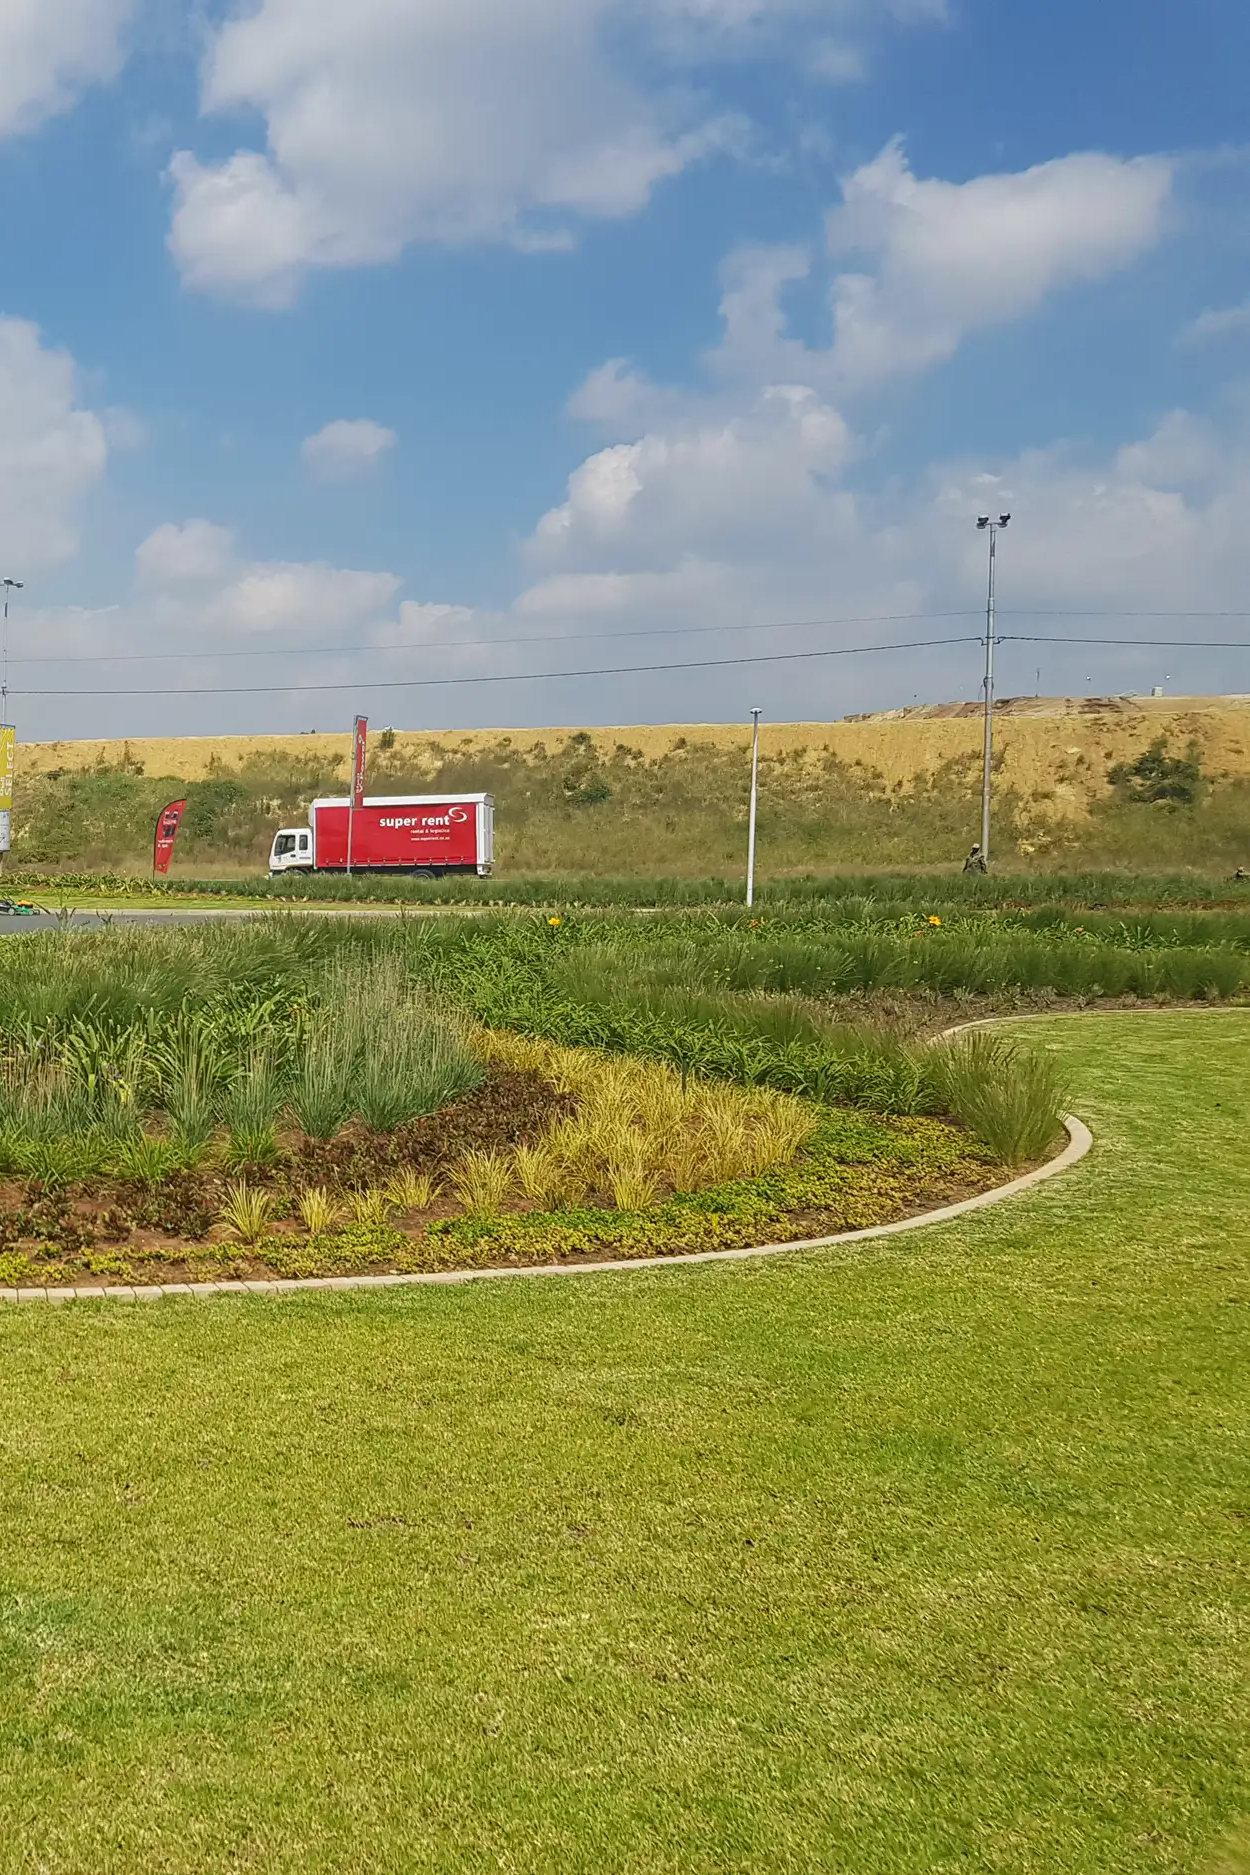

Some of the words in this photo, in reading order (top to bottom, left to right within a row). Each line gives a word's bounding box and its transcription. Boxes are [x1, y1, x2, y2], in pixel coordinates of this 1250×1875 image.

[5, 742, 14, 796] SELECT
[379, 817, 417, 829] super
[421, 815, 450, 826] rent
